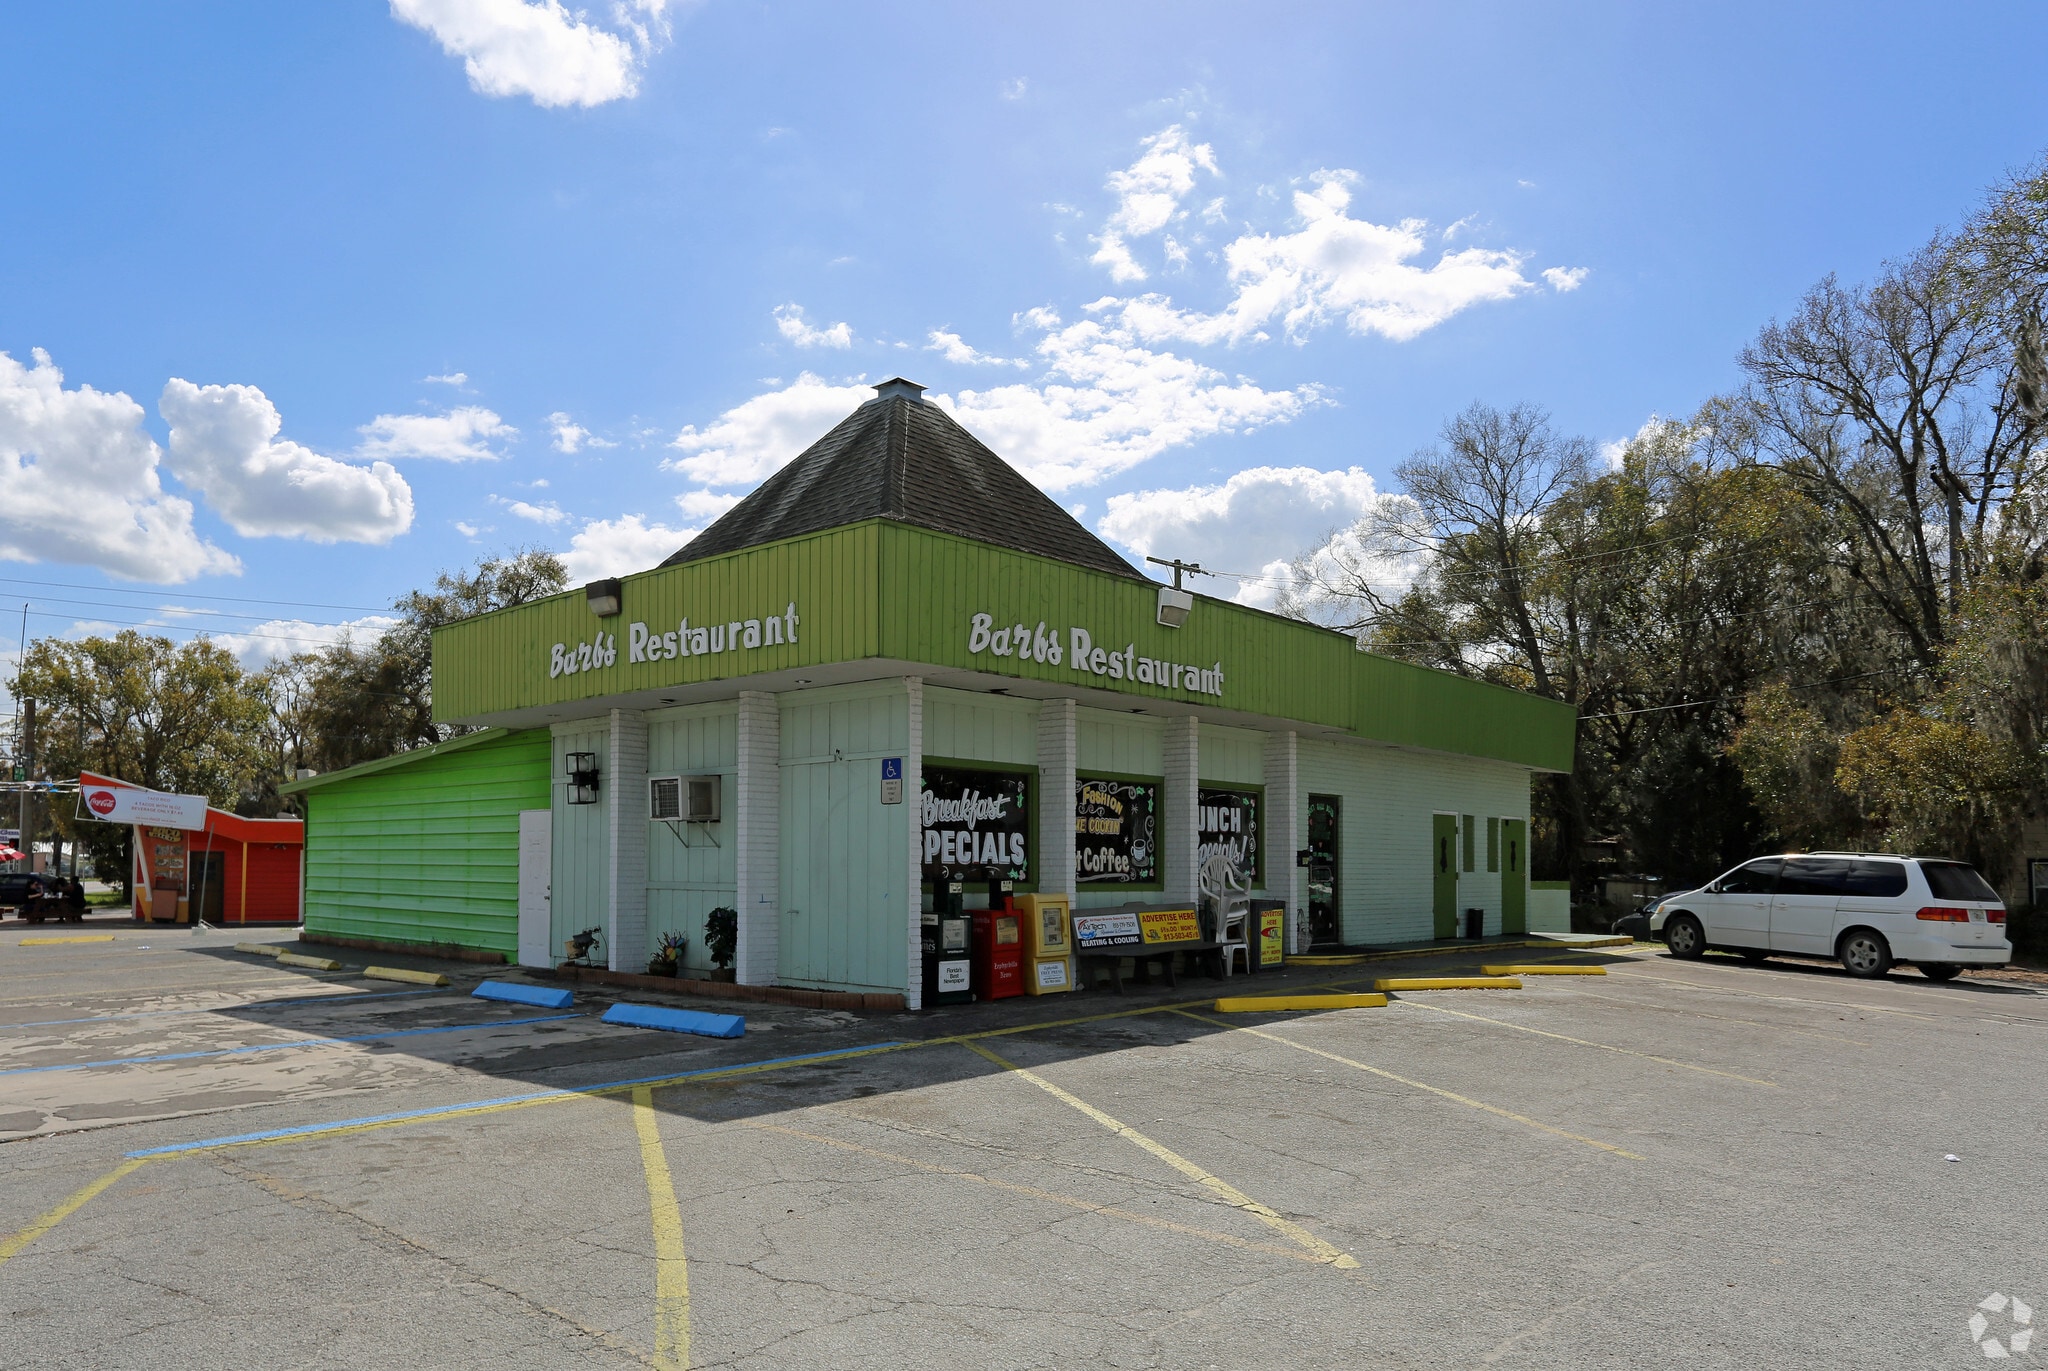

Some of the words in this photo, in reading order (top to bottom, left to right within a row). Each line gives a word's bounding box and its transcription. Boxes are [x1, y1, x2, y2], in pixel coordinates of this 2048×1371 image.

[629, 601, 800, 664] Restaurant
[1069, 626, 1225, 697] Restaurant
[920, 788, 1011, 830] Breakfast
[1198, 805, 1241, 833] UNCH
[921, 830, 1025, 865] PECIALS
[1083, 846, 1130, 872] Coffee
[1198, 834, 1248, 868] pecials!
[1083, 922, 1106, 930] AirTech
[1142, 914, 1177, 923] ADVERTISE
[1178, 912, 1196, 920] HERE
[1081, 938, 1108, 948] HEATING
[1114, 936, 1139, 945] COOLING
